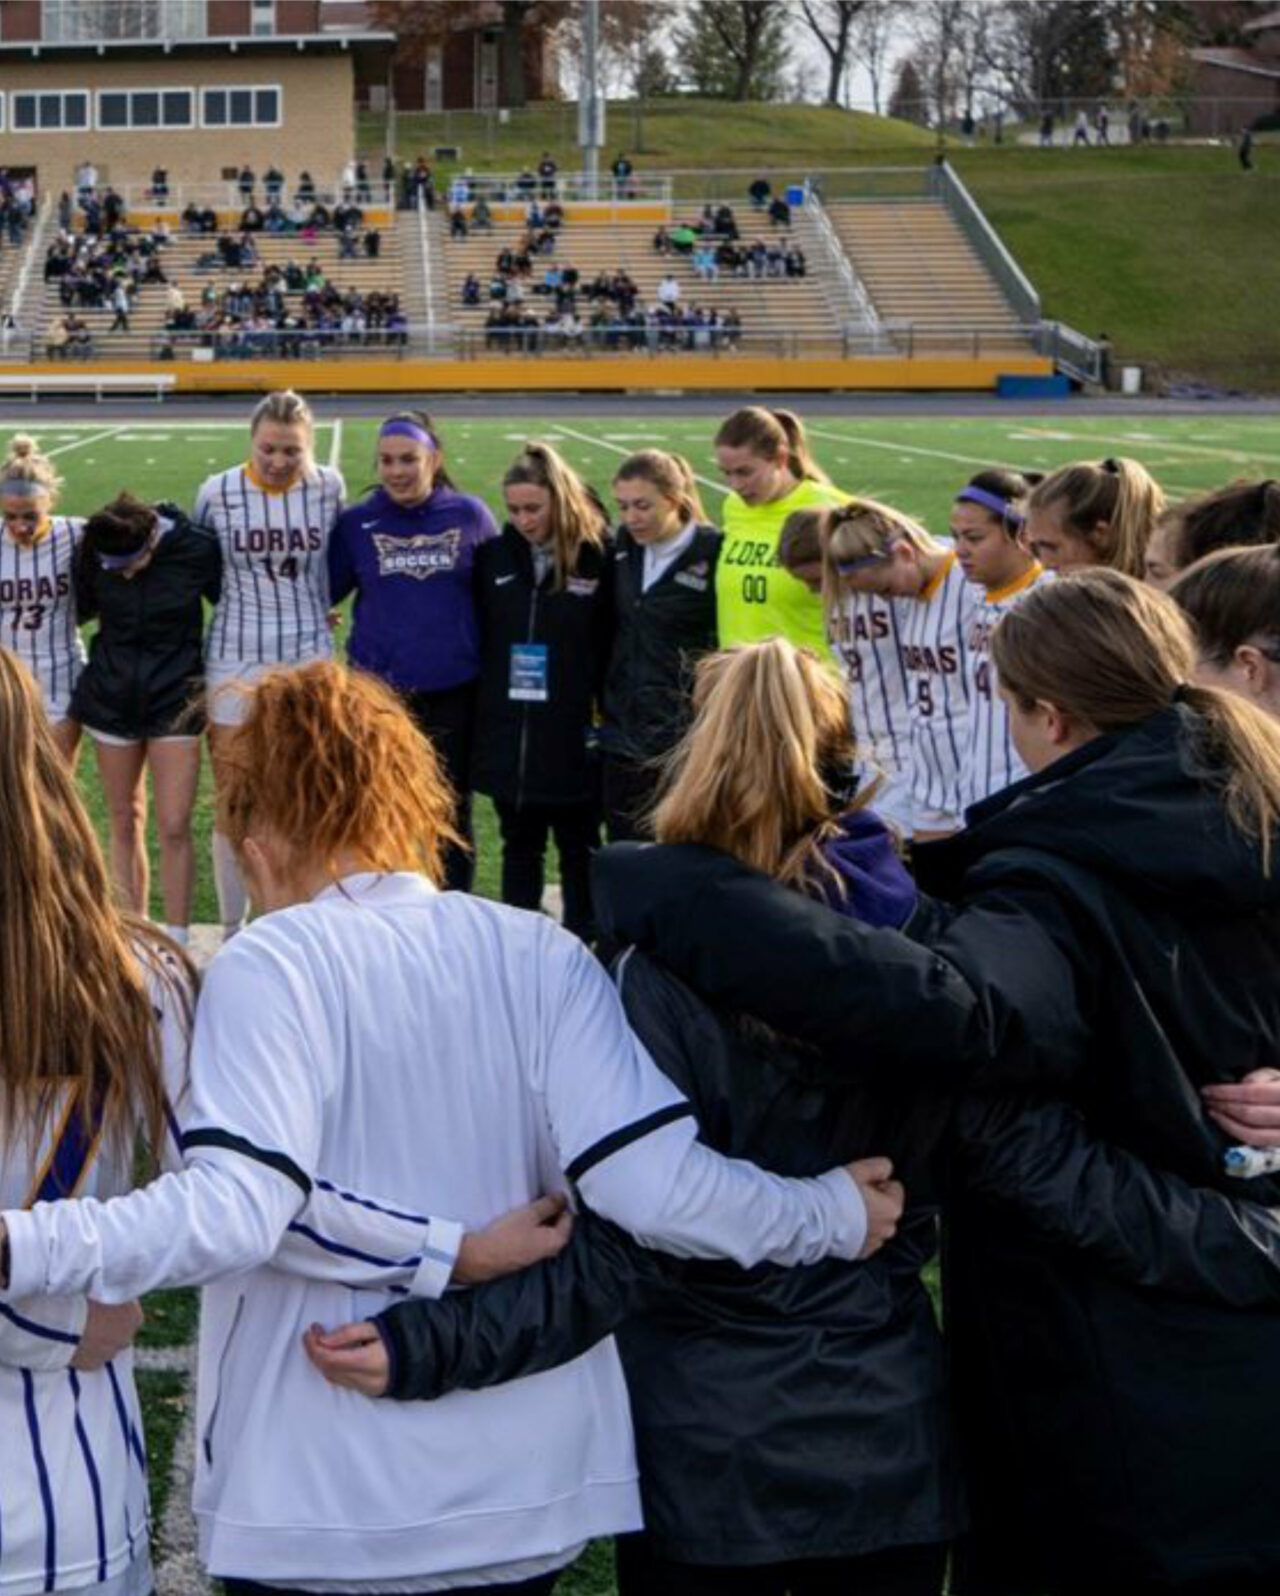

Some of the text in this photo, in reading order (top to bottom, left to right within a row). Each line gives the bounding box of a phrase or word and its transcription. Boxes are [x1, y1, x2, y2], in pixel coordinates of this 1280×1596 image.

[233, 526, 322, 553] LORAS
[259, 556, 299, 582] 14
[383, 553, 451, 569] SOCCER
[742, 574, 767, 604] 00
[10, 604, 47, 631] 13
